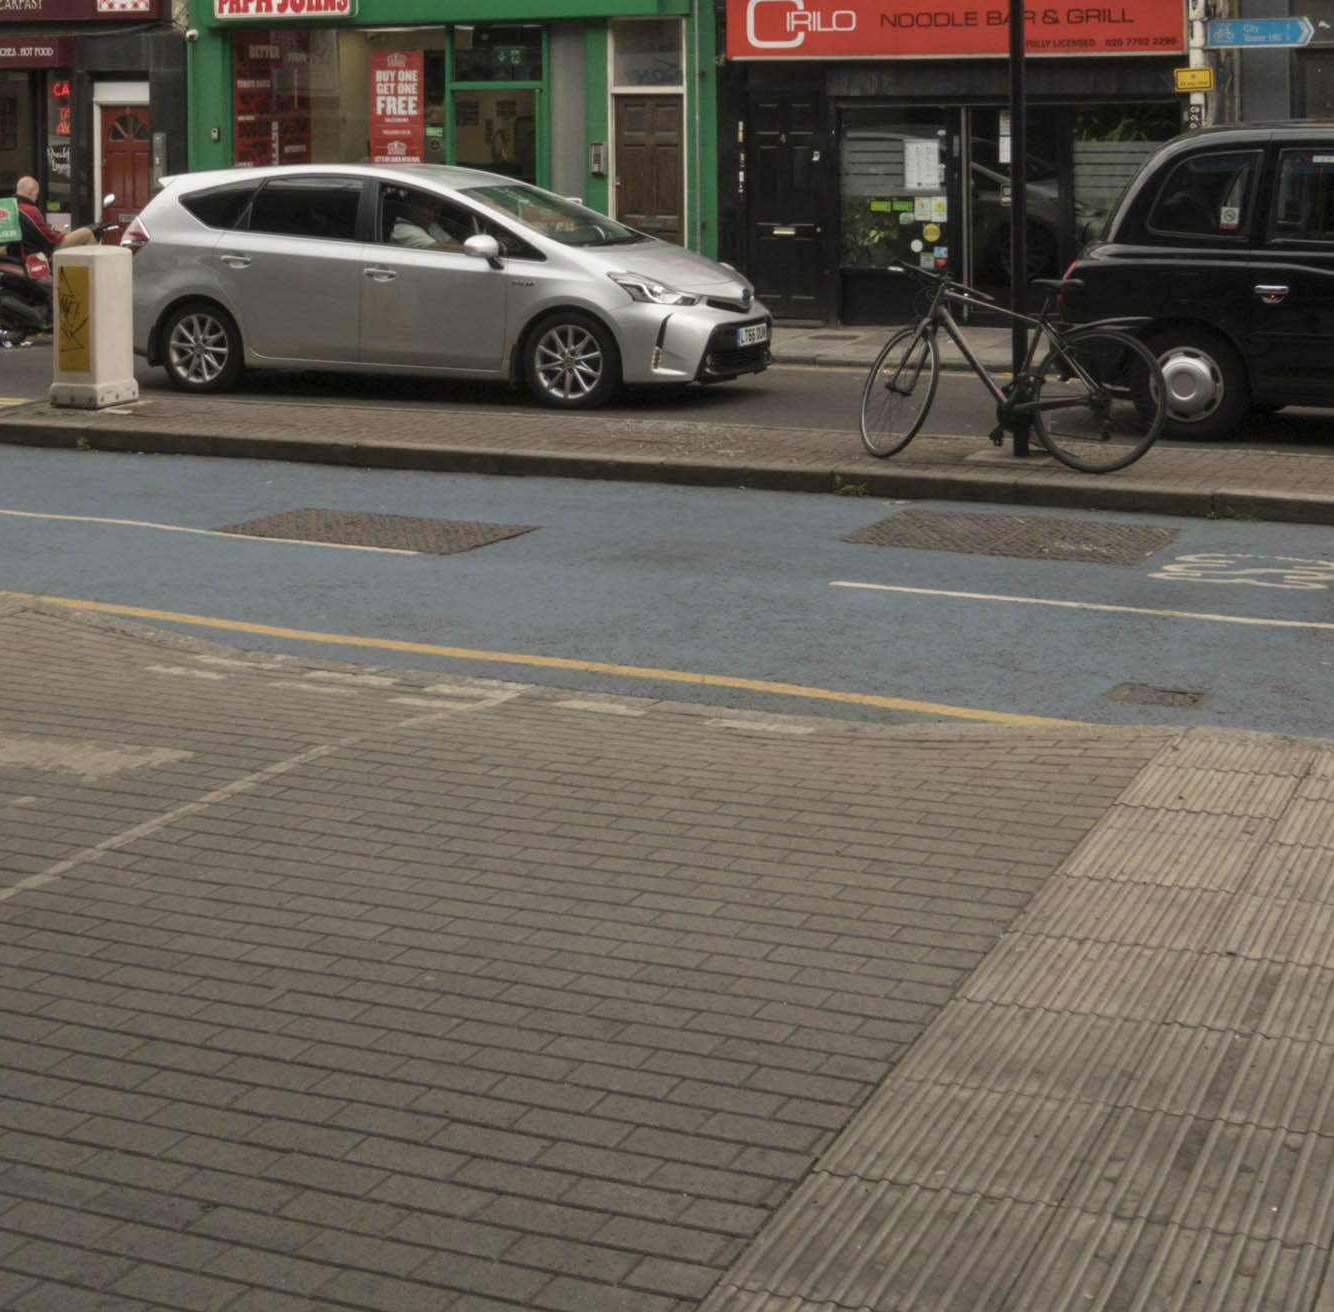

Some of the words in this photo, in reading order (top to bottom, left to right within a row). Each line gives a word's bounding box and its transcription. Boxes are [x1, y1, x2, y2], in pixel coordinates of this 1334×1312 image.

[880, 10, 979, 29] NOODLE
[1041, 8, 1061, 25] &
[1066, 7, 1135, 24] GRILL
[1243, 24, 1260, 33] City
[1053, 38, 1096, 48] LICENSED
[20, 47, 33, 57] HOT
[34, 46, 54, 57] FOOD
[375, 69, 396, 82] BUY
[397, 69, 418, 82] ONE
[376, 82, 396, 95] GET
[397, 82, 418, 95] ONE
[376, 95, 419, 116] FREE
